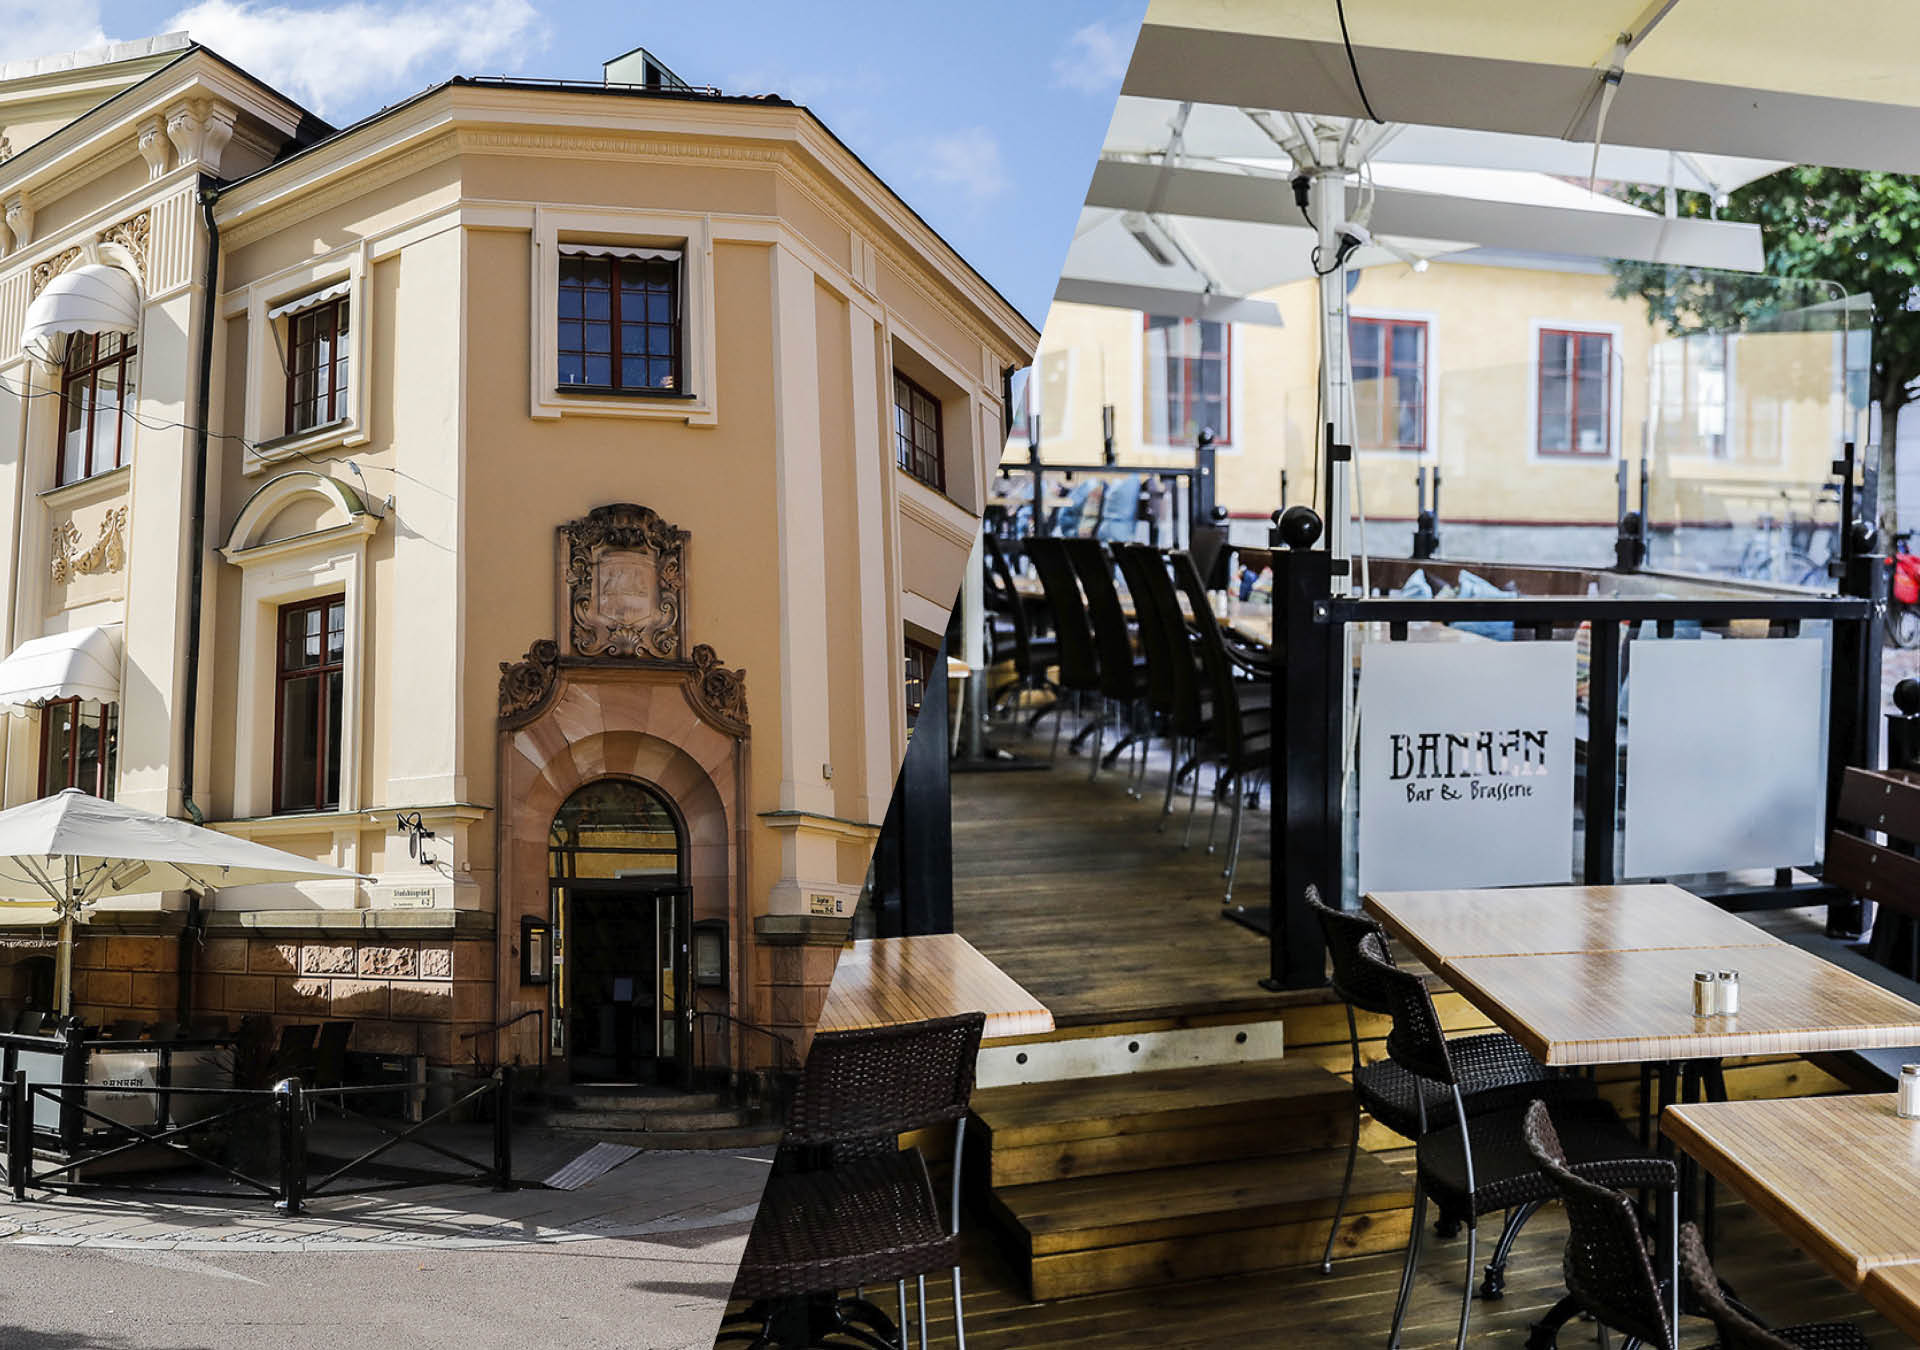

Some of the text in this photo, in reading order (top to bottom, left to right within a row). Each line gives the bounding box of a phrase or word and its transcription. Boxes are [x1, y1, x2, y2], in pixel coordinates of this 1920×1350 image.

[1389, 729, 1549, 780] BANKEN
[1406, 780, 1533, 803] Bar & Brasserie
